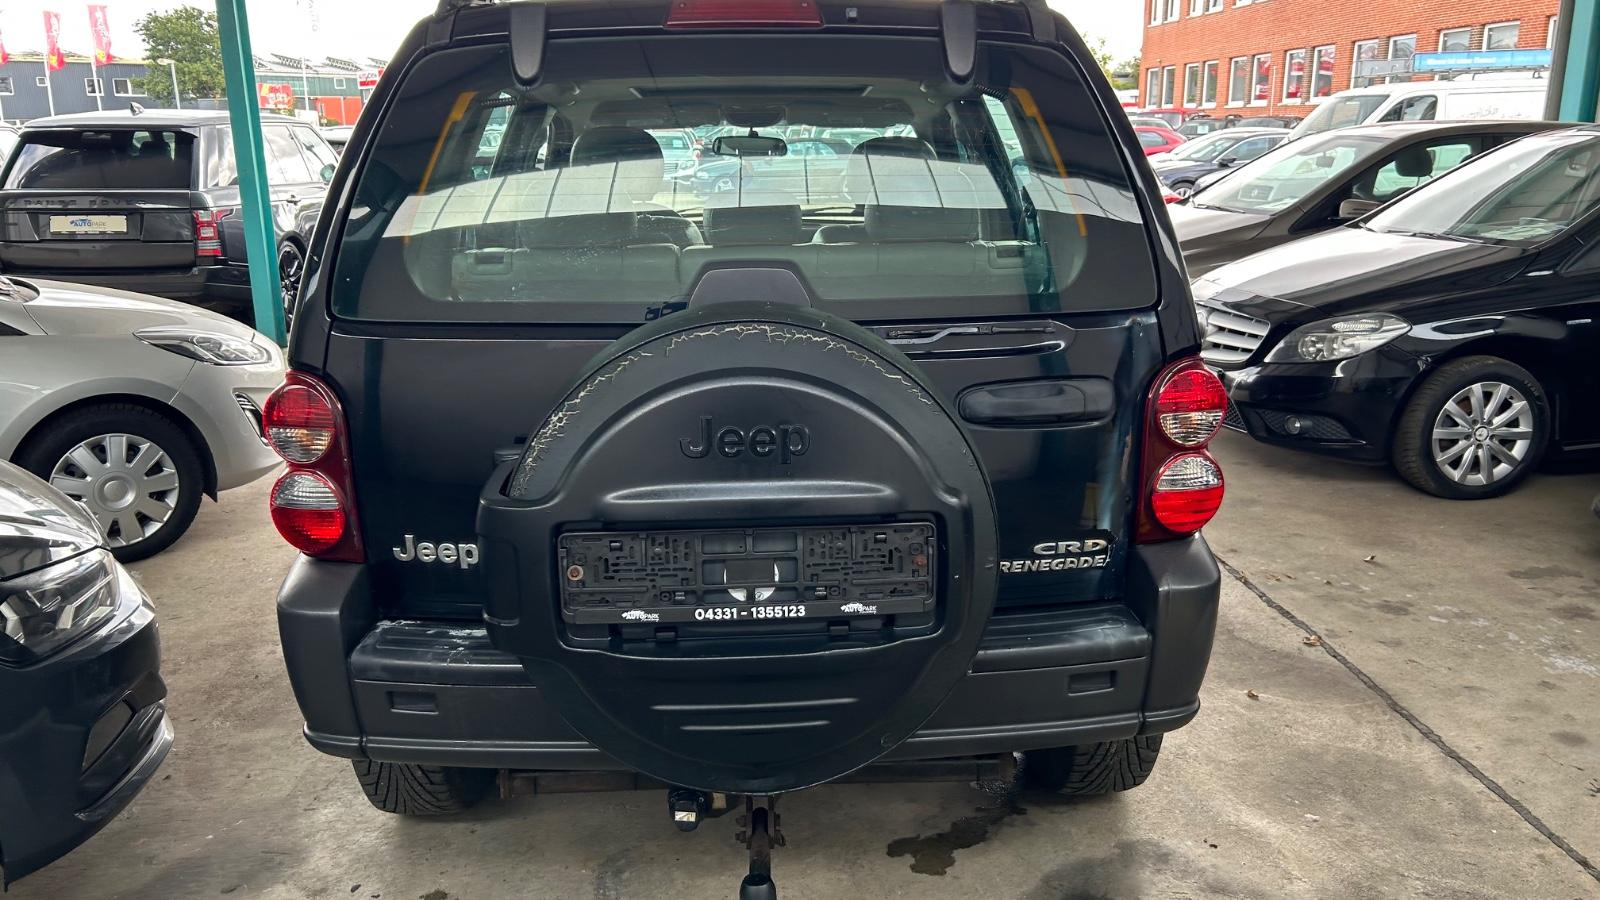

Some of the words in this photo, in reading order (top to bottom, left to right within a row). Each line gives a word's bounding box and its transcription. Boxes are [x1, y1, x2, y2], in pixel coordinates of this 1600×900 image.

[679, 415, 811, 465] Jeep
[392, 534, 479, 569] Jeep
[1033, 539, 1108, 555] CRD
[1000, 555, 1107, 573] RENEGADE
[625, 611, 660, 620] AUTOPARK
[694, 607, 738, 621] 04331
[750, 605, 806, 619] 1355123
[844, 604, 877, 613] AUTOPARK
